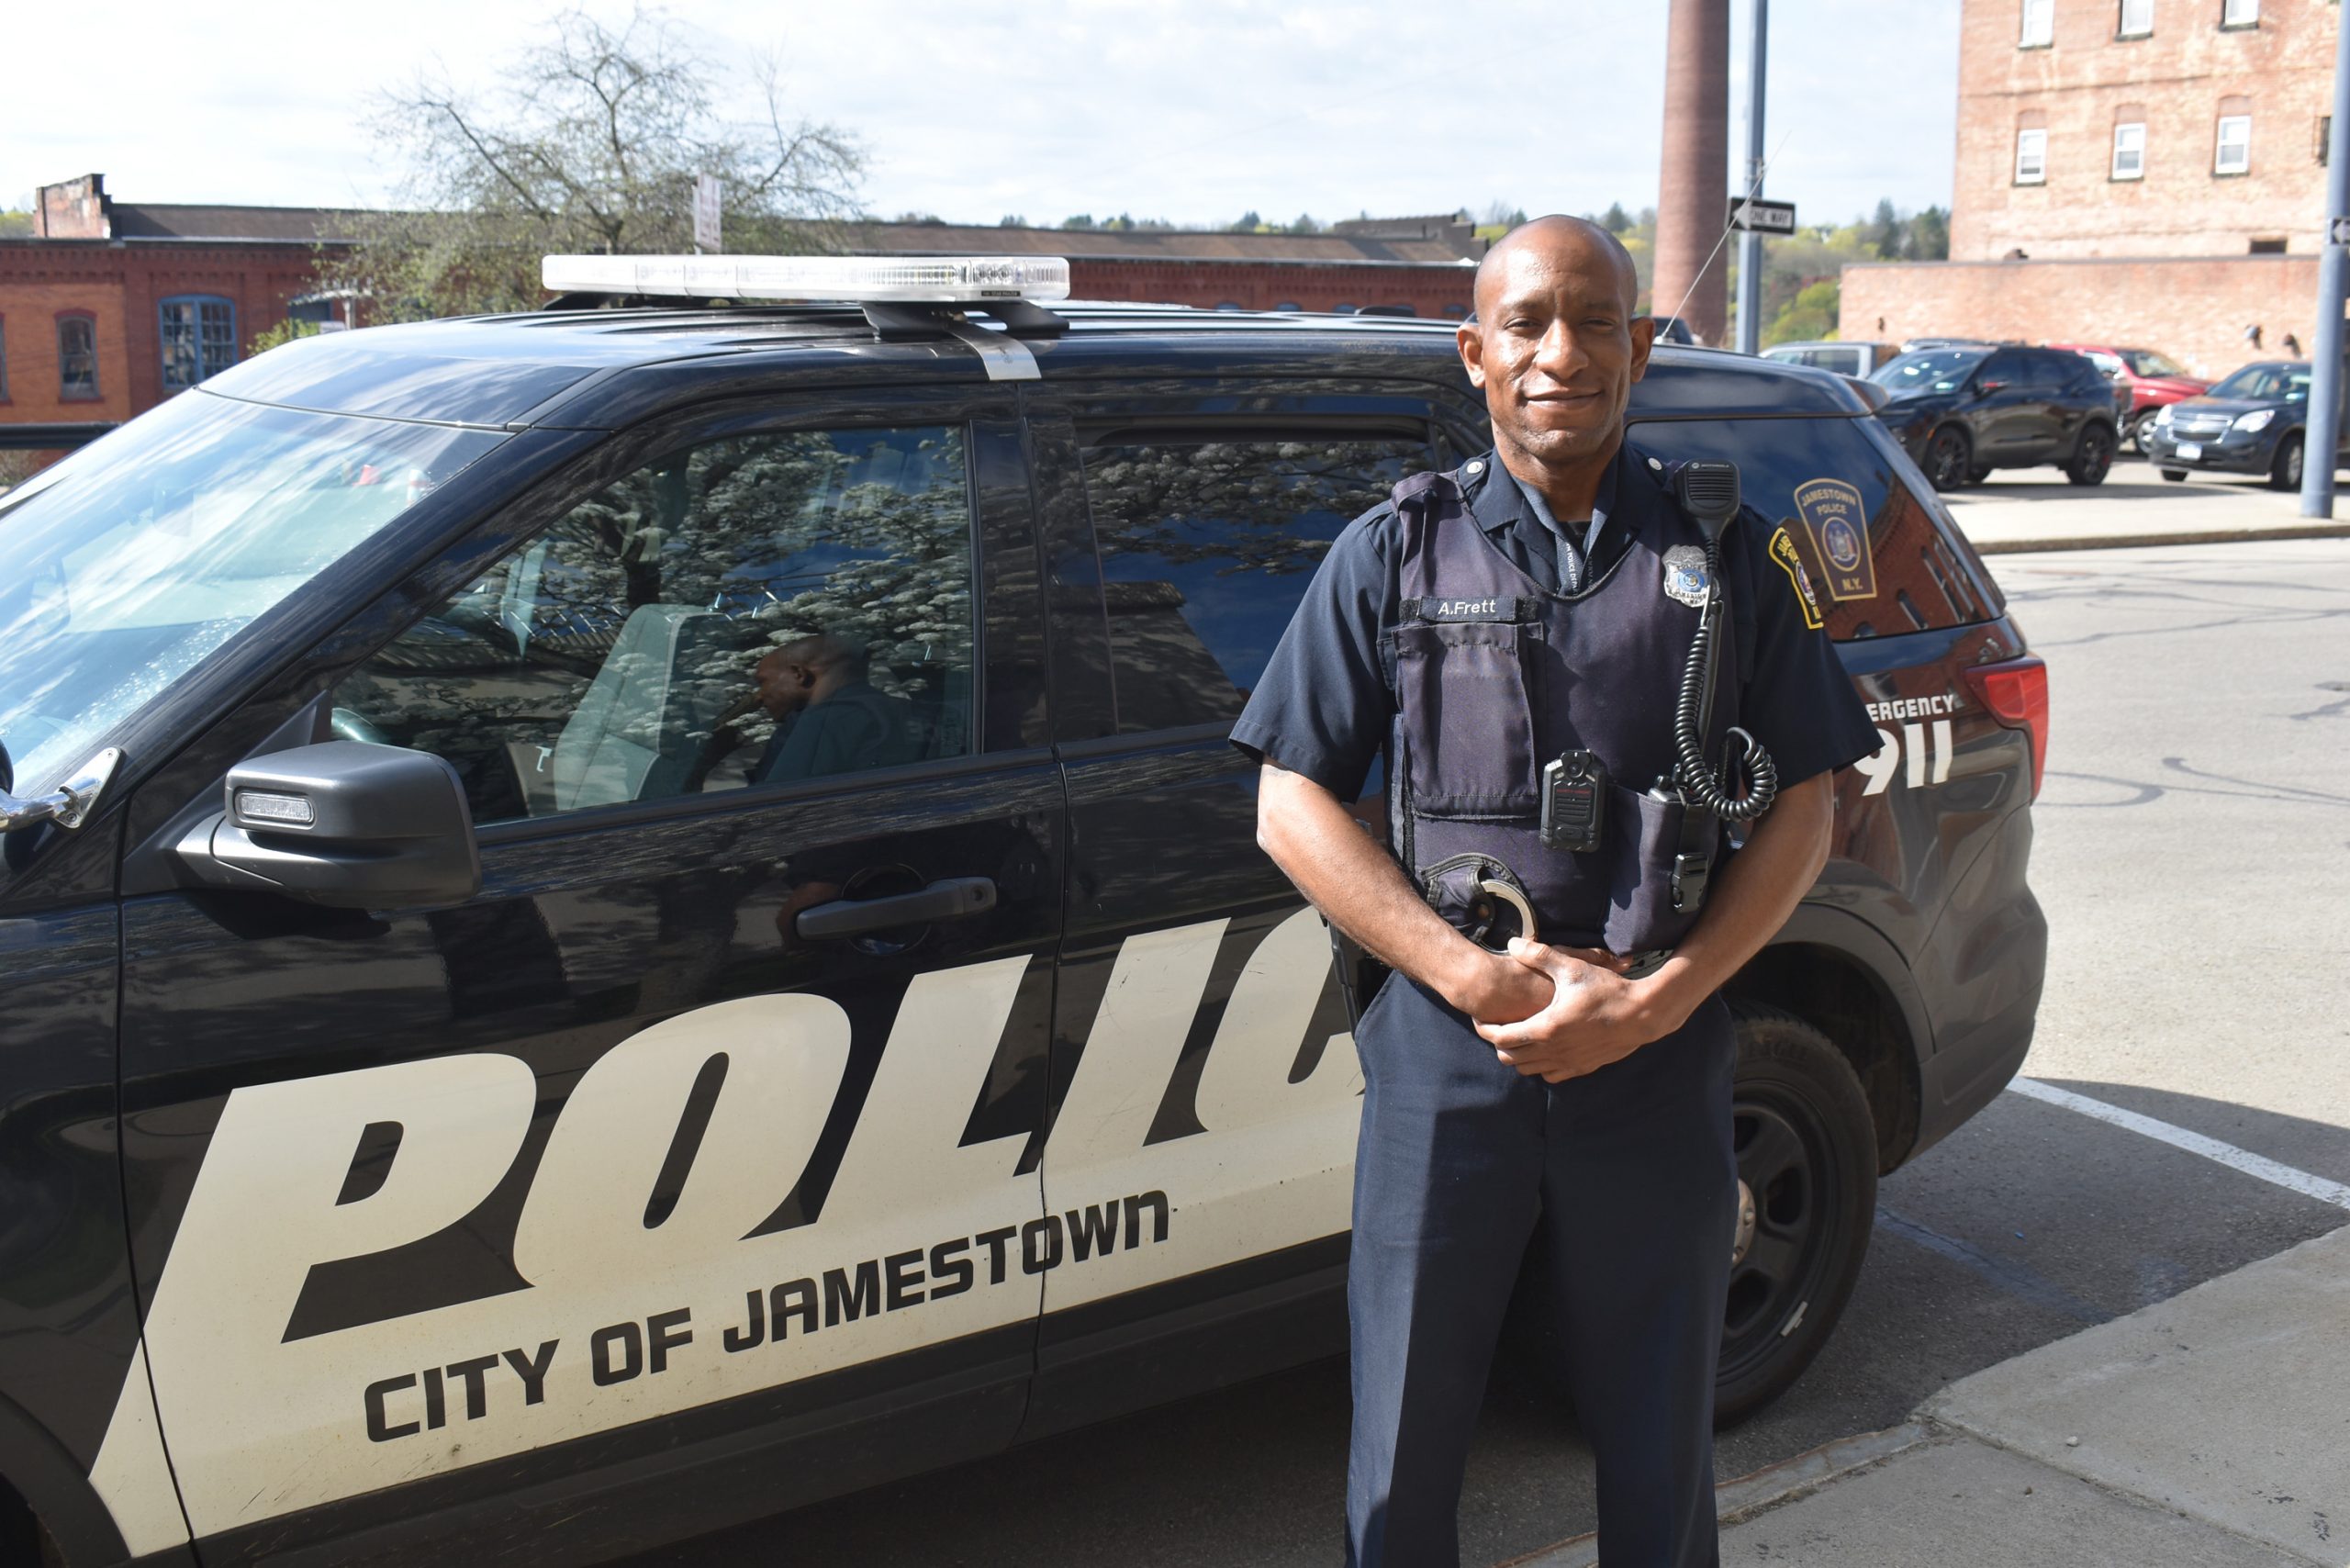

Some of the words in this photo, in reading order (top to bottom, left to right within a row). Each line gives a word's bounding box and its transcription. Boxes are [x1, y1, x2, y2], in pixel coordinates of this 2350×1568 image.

[1750, 208, 1768, 223] ONE
[1770, 212, 1790, 224] WAY
[1801, 488, 1857, 508] JAMESTOWN
[1816, 505, 1848, 516] POLICE
[1841, 577, 1863, 591] N.Y.
[1438, 599, 1496, 615] A.Frett
[1865, 694, 1954, 722] ERGENCY
[1852, 720, 1953, 796] 911
[115, 907, 1365, 1386] POLIC
[364, 1338, 560, 1444] CITY
[590, 1307, 694, 1387] OF
[722, 1190, 1169, 1353] JAMESTOWN
